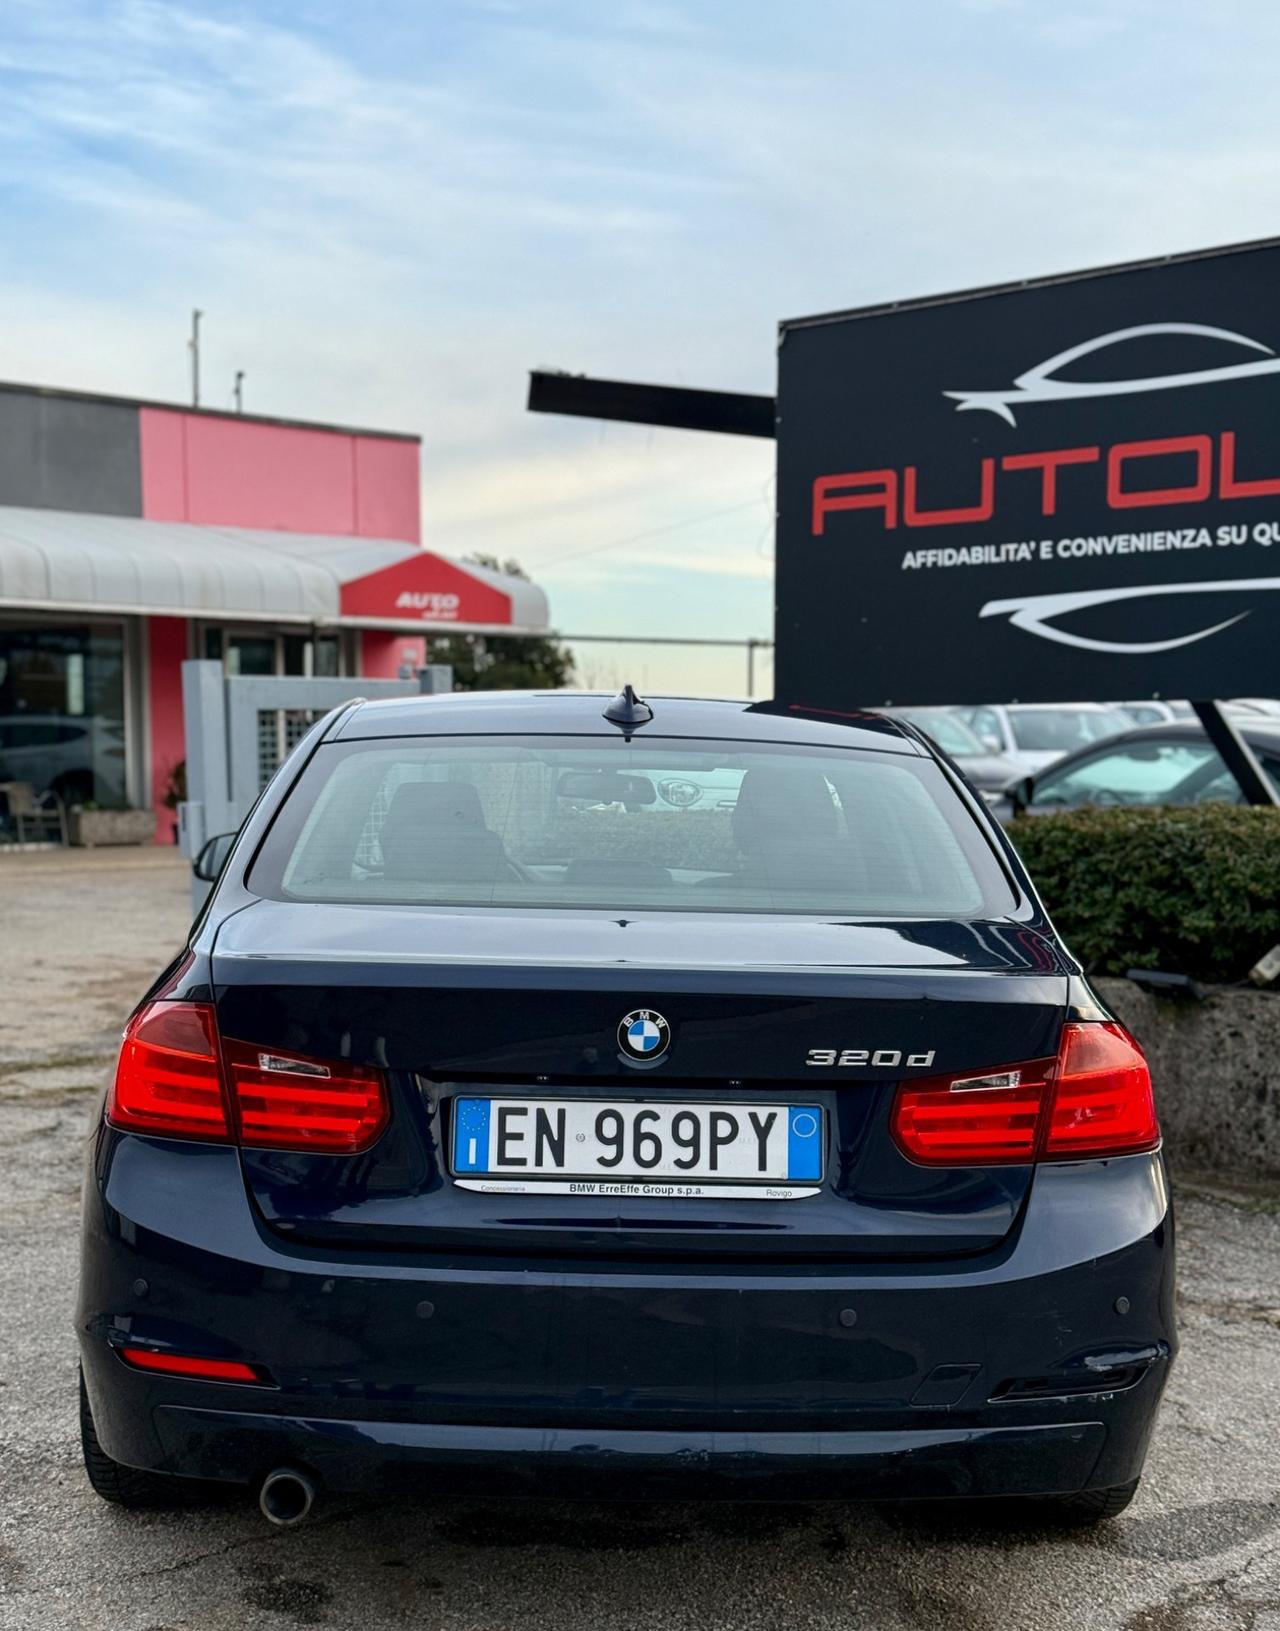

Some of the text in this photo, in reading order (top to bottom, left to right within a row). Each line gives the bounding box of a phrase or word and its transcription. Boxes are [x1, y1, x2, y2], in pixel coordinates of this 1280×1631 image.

[902, 541, 1036, 570] AFFIDABILITA'
[1040, 541, 1053, 559] E
[1057, 527, 1213, 558] CONVENIENZA
[1216, 524, 1248, 546] SU
[396, 591, 460, 609] AUTO
[623, 1011, 667, 1029] BMW
[497, 1107, 778, 1172] EN 969PY
[569, 1184, 704, 1197] BMW ErreEffe Group s.p.a.
[766, 1189, 793, 1199] Rovigo
